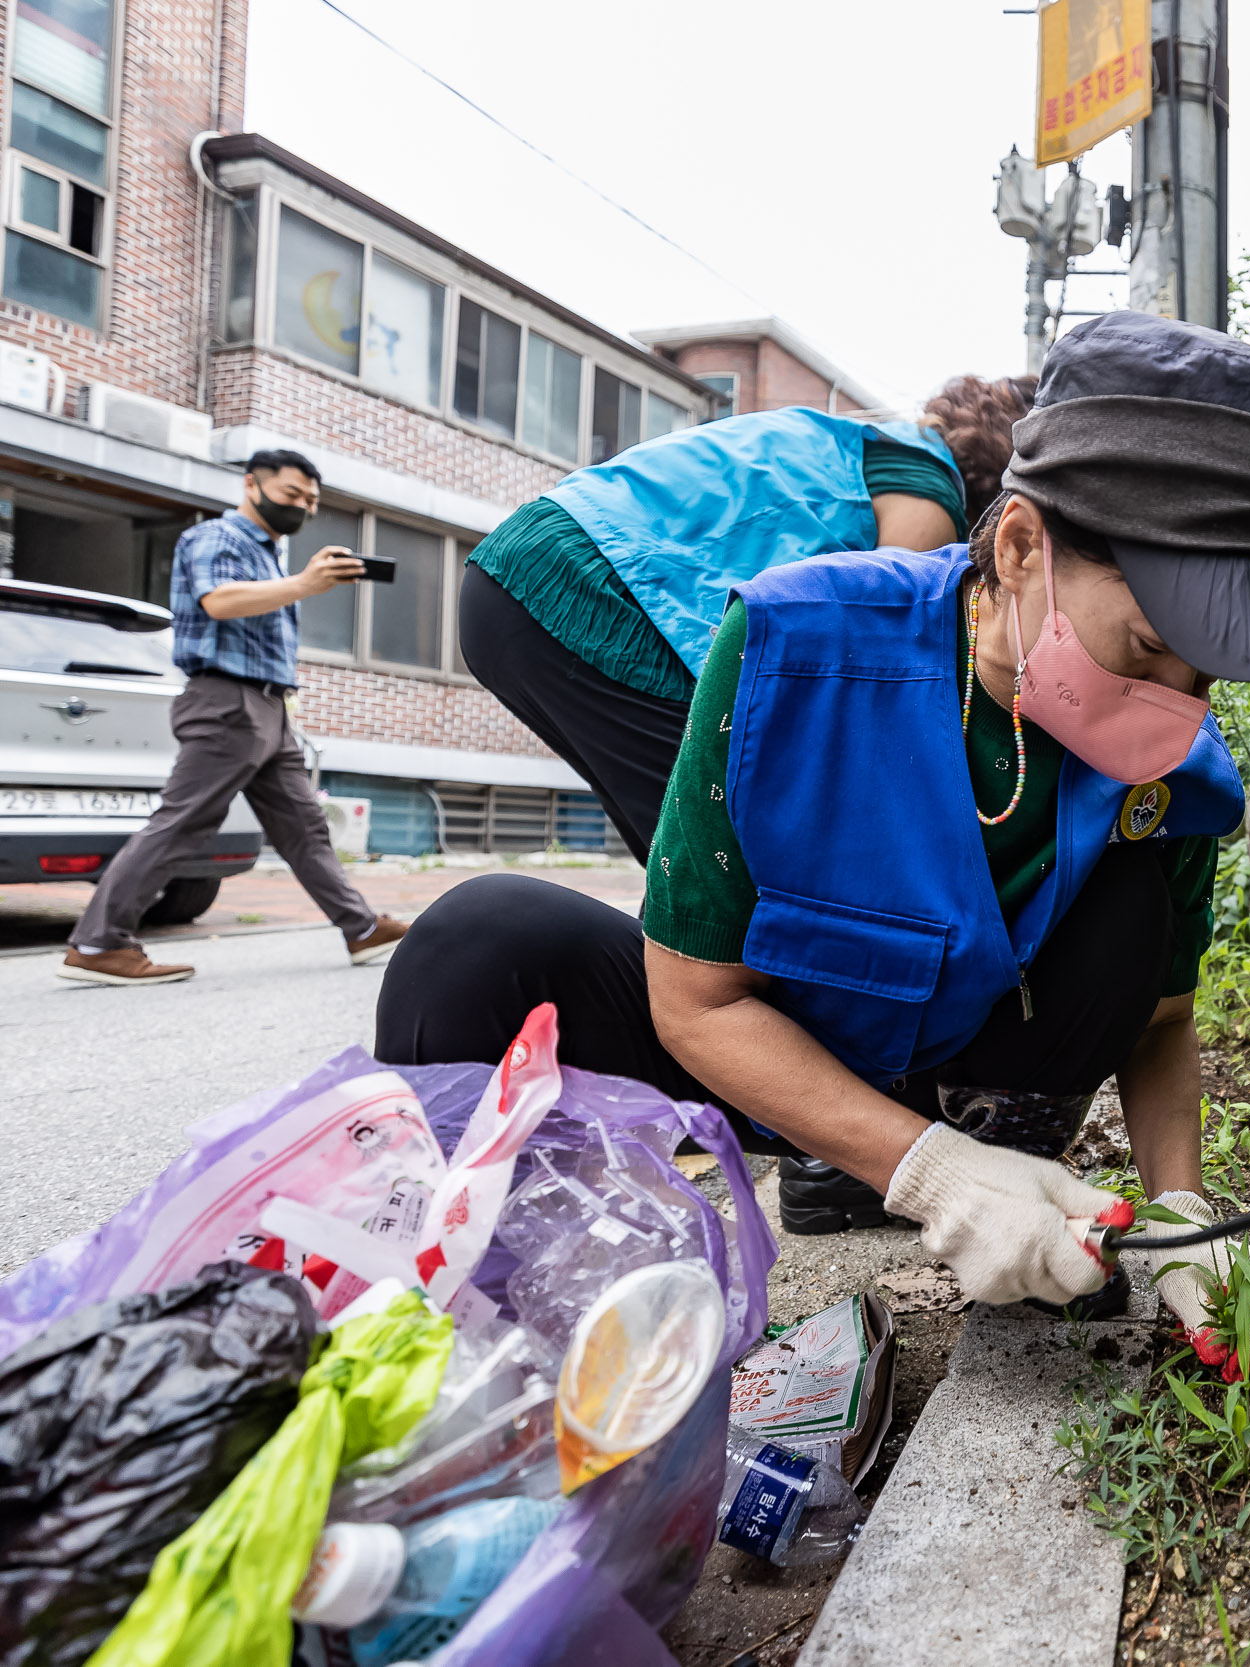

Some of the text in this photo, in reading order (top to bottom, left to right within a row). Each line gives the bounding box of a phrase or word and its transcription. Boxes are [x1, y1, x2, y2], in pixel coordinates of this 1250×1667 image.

[731, 1379, 769, 1392] ZZA
[730, 1387, 766, 1400] ANT
[729, 1397, 761, 1408] ZZA
[746, 1492, 777, 1538] 탐사수
